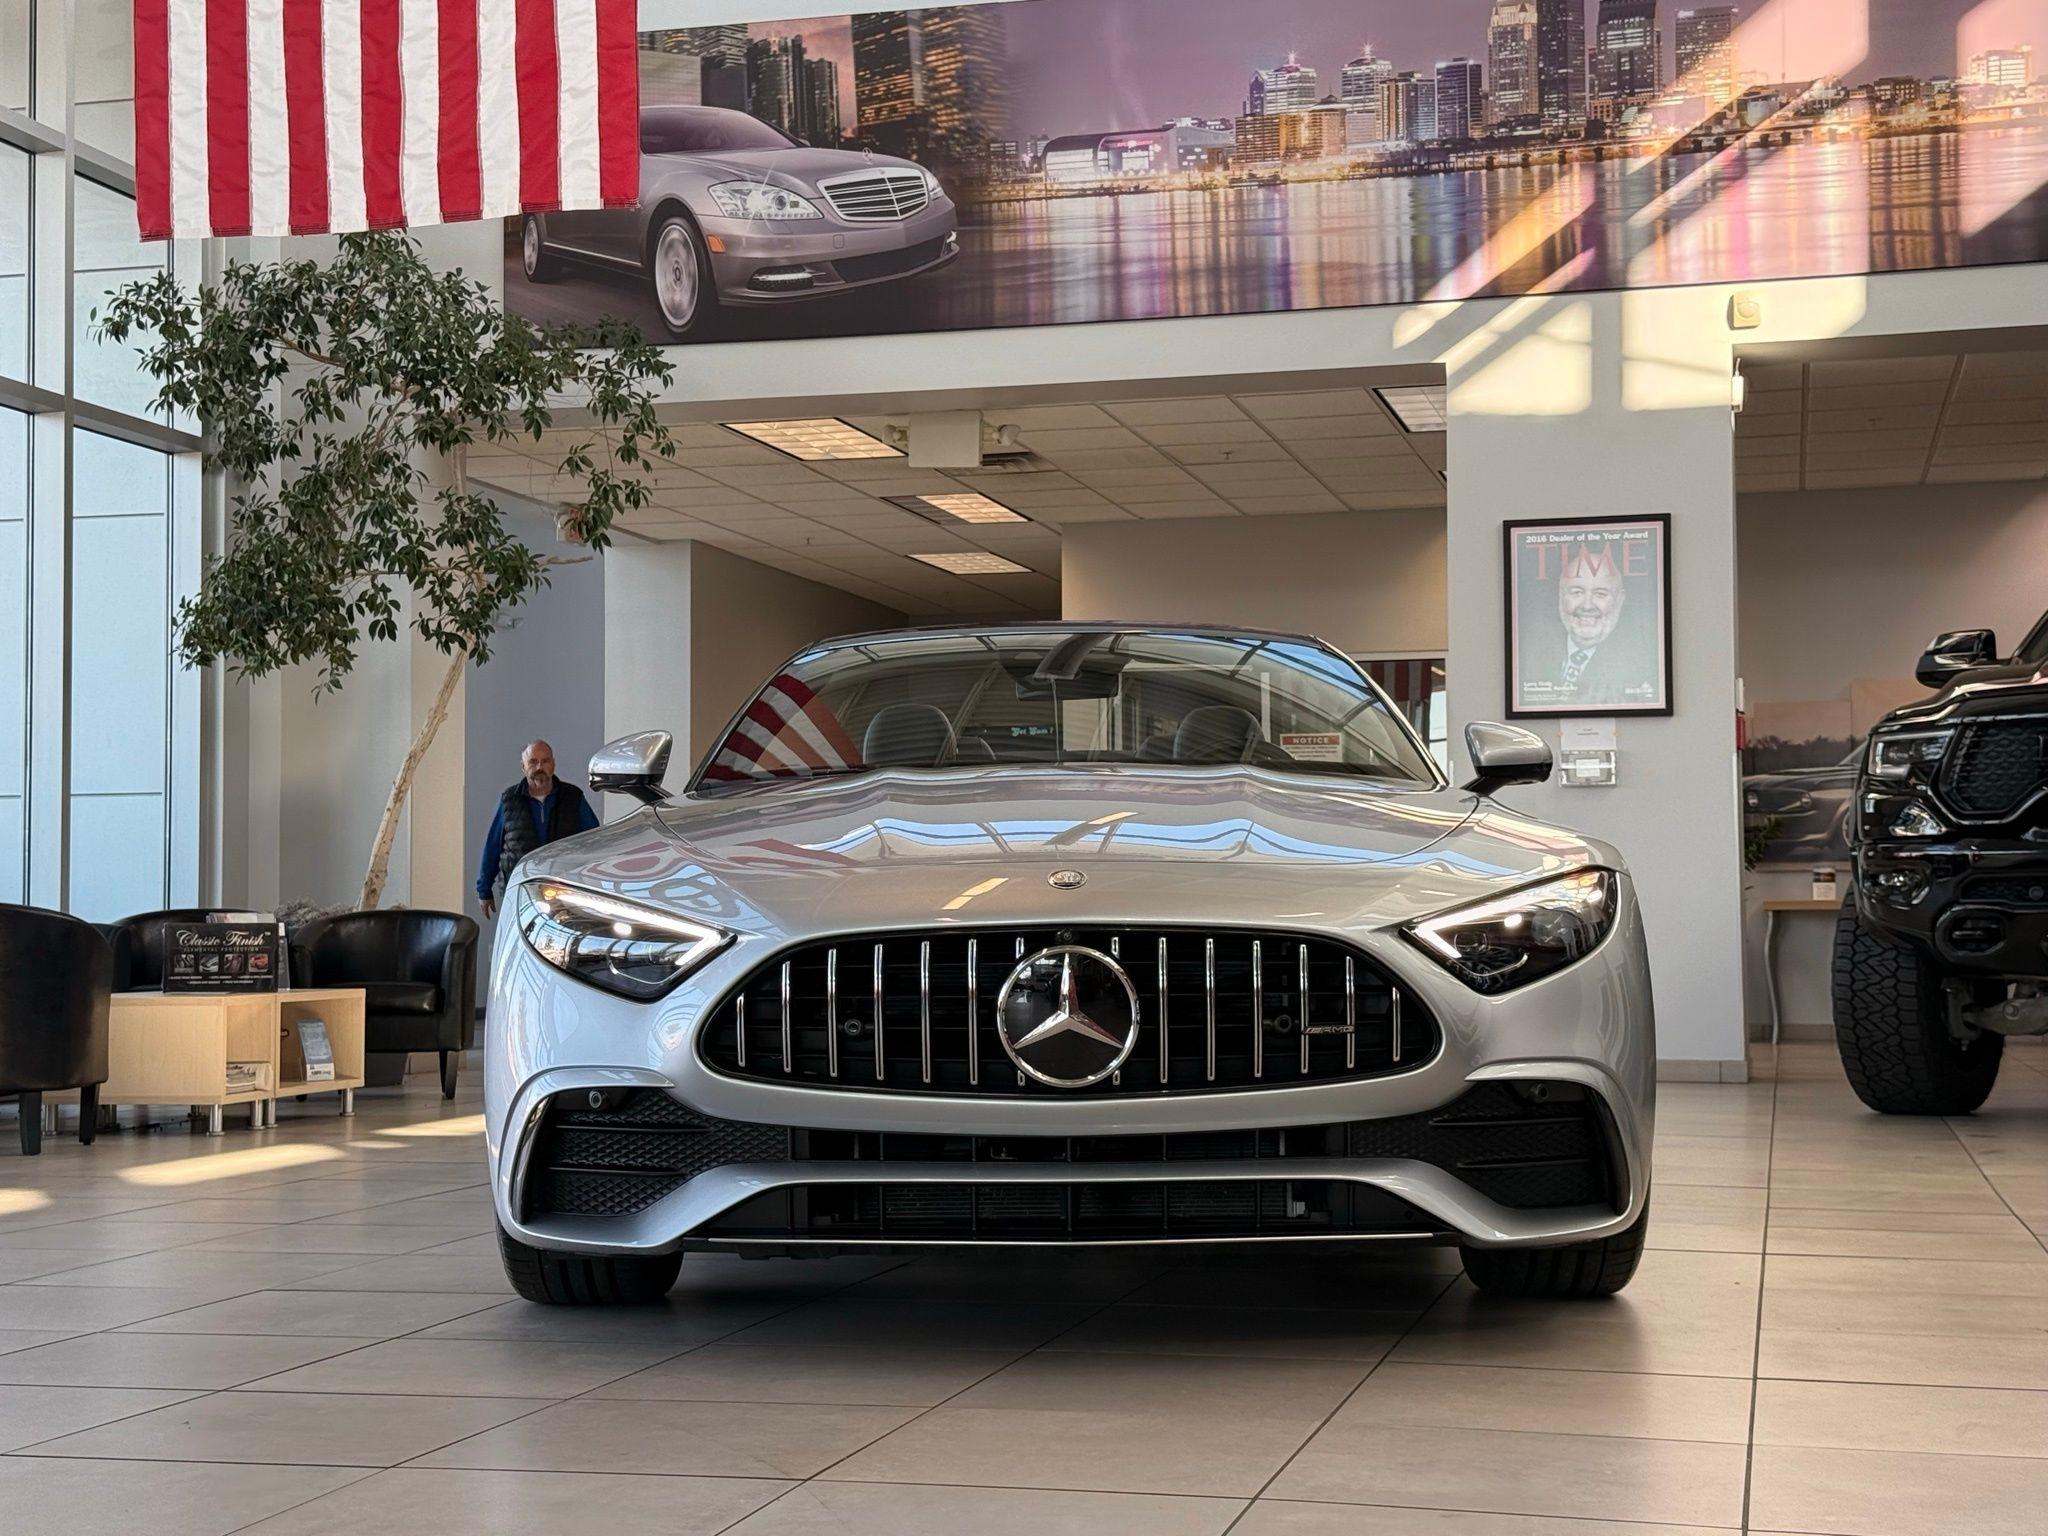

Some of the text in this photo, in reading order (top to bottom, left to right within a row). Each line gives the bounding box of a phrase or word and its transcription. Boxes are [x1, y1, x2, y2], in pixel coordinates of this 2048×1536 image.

[1526, 531, 1648, 544] 2016 Dealer of the Year Award
[1526, 539, 1648, 581] TIME
[176, 929, 266, 947] Classic Finish
